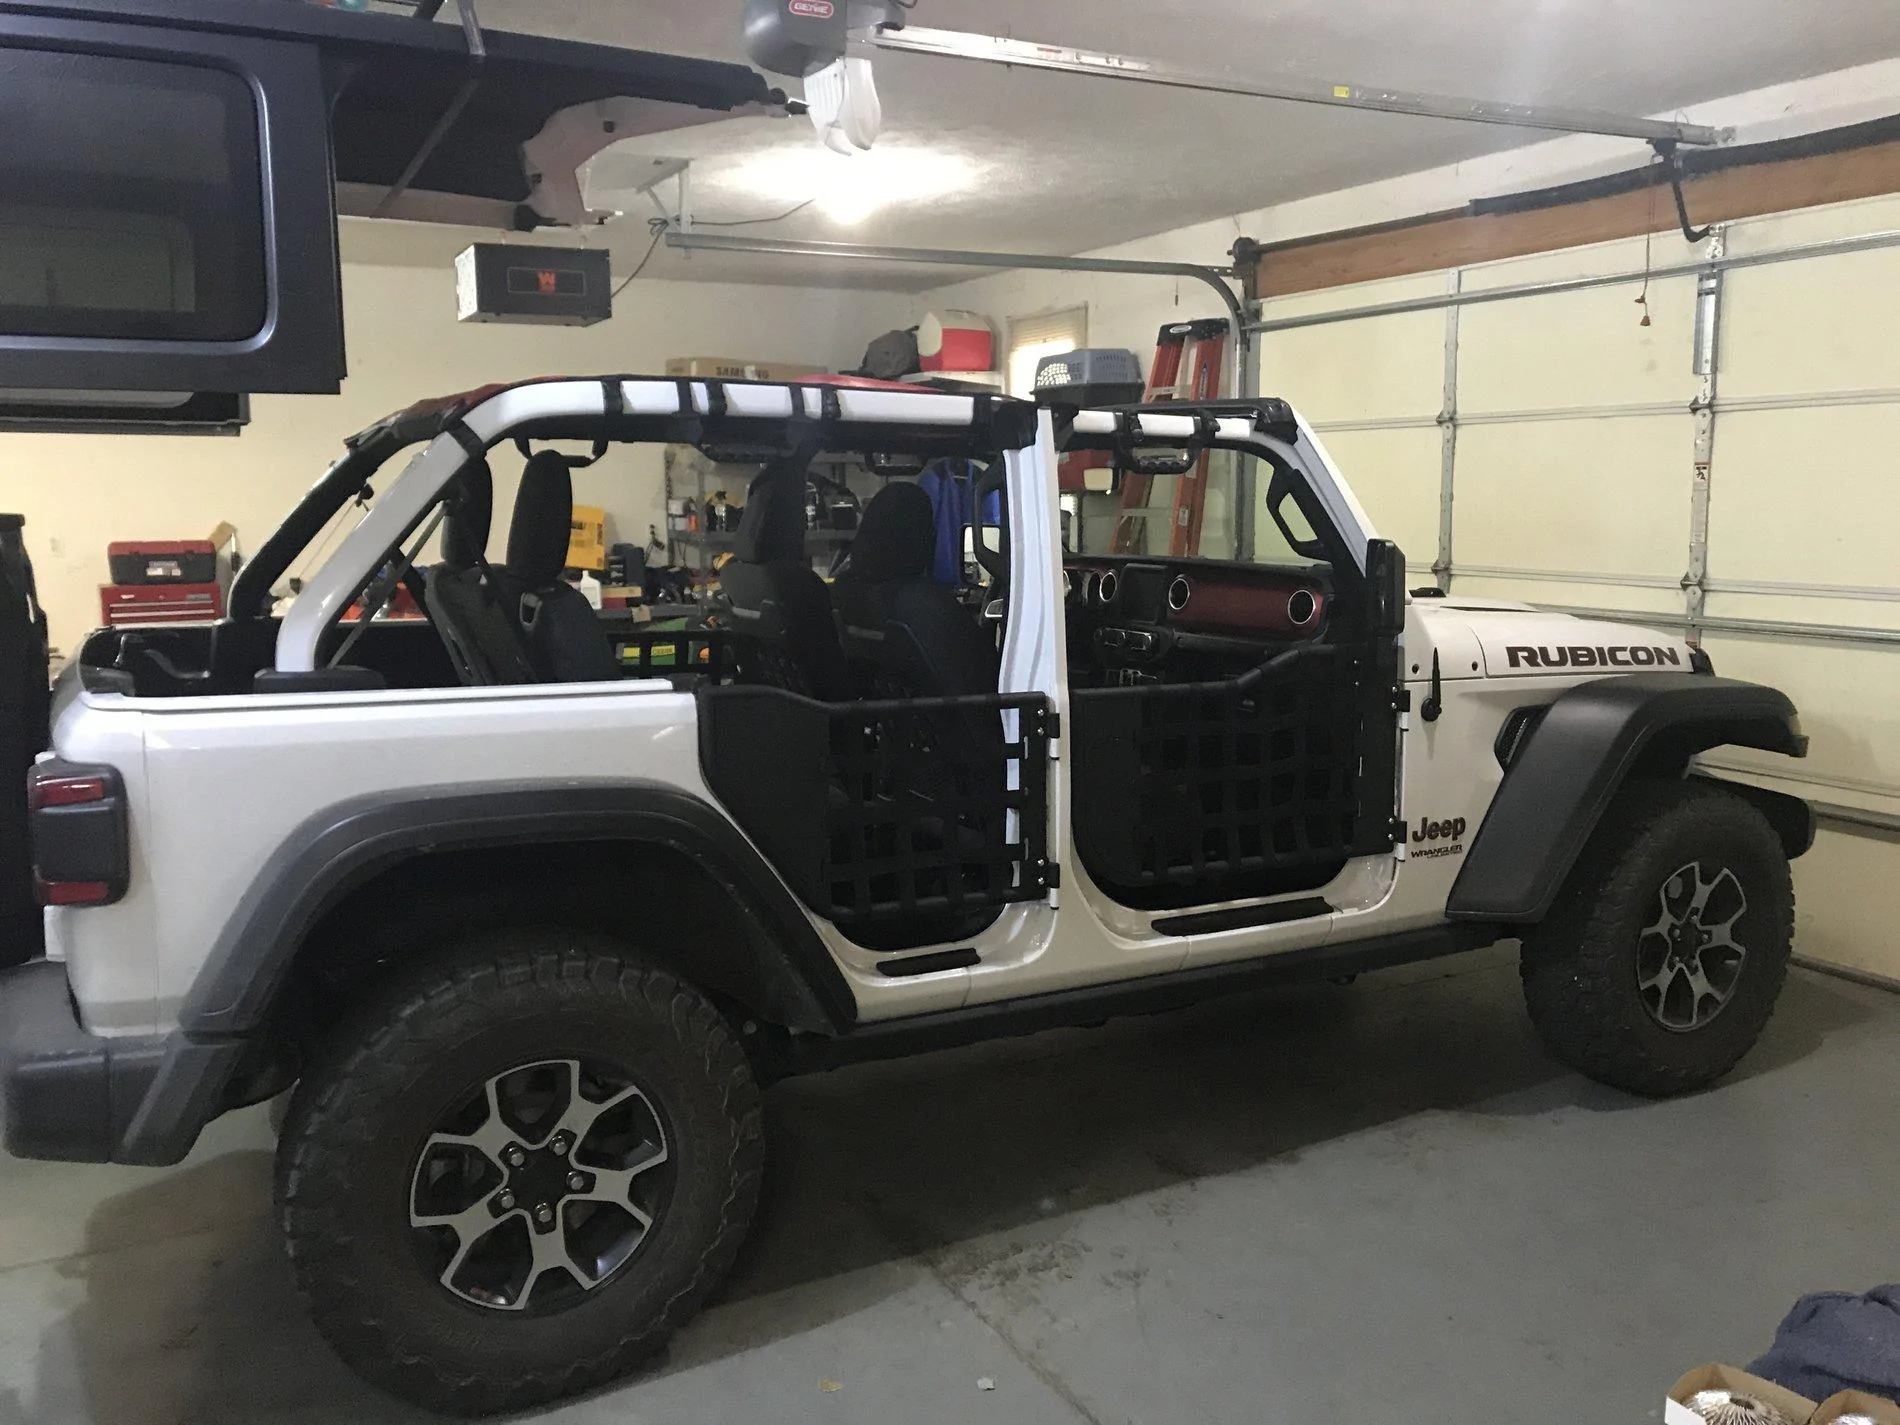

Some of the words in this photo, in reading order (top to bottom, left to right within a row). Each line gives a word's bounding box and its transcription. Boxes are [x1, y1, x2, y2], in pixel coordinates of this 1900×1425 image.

[794, 2, 829, 14] GENIE
[715, 366, 770, 379] SAMSNG
[1505, 646, 1681, 668] RUBICON
[1411, 816, 1467, 843] Jeep
[1410, 844, 1463, 858] WRANGLER
